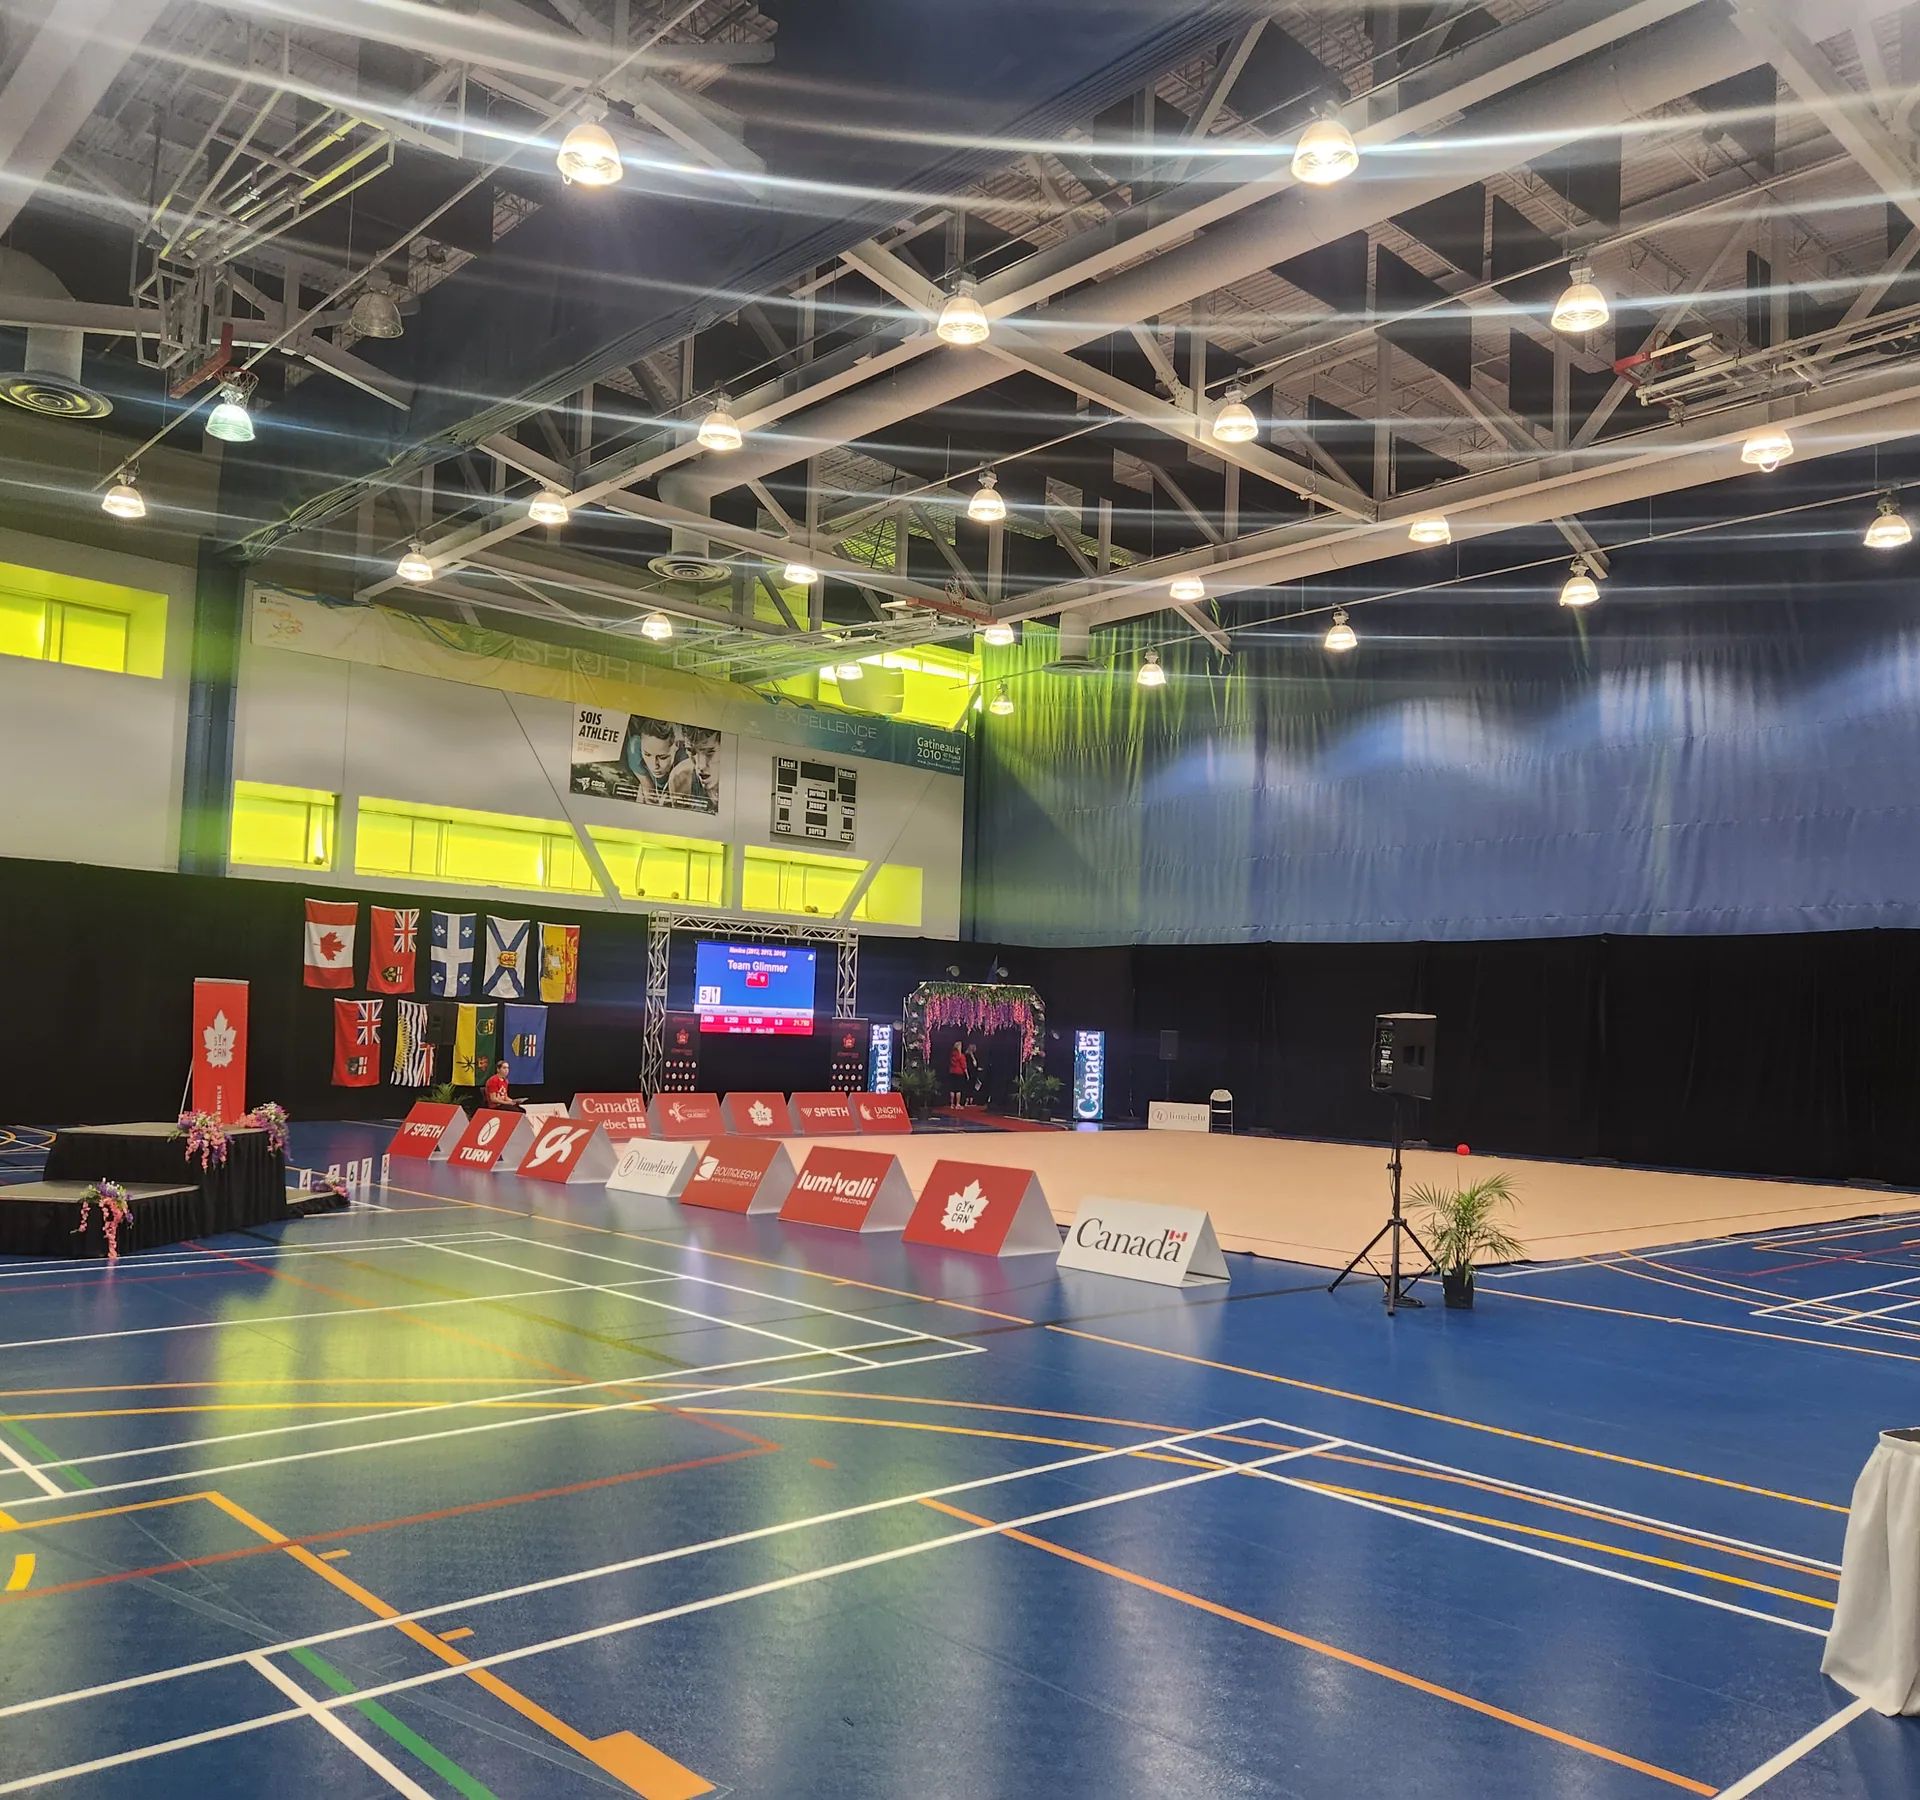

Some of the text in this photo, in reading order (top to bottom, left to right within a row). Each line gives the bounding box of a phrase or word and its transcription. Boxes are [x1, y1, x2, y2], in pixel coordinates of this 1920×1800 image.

[579, 710, 602, 726] SOIS
[775, 708, 878, 740] EXCELLENCE
[578, 725, 619, 743] ATHLÈTE
[917, 737, 954, 753] Gatineau
[917, 747, 942, 760] 2010
[780, 759, 796, 768] Local
[728, 959, 788, 973] Team Glimmer
[701, 990, 707, 1000] 5
[1078, 1032, 1101, 1119] Canada
[582, 1098, 641, 1114] Canada
[813, 1107, 850, 1117] SPIETH
[874, 1106, 904, 1115] UNIGYM
[1168, 1110, 1207, 1123] limelight
[411, 1122, 445, 1138] SPIETH
[458, 1146, 493, 1164] TURN
[636, 1156, 678, 1176] limelight
[713, 1166, 762, 1181] BOUTIQUEGYM
[797, 1169, 878, 1199] lum!valli
[955, 1201, 975, 1214] GYM
[951, 1212, 969, 1225] CAN
[1076, 1217, 1182, 1264] Canada
